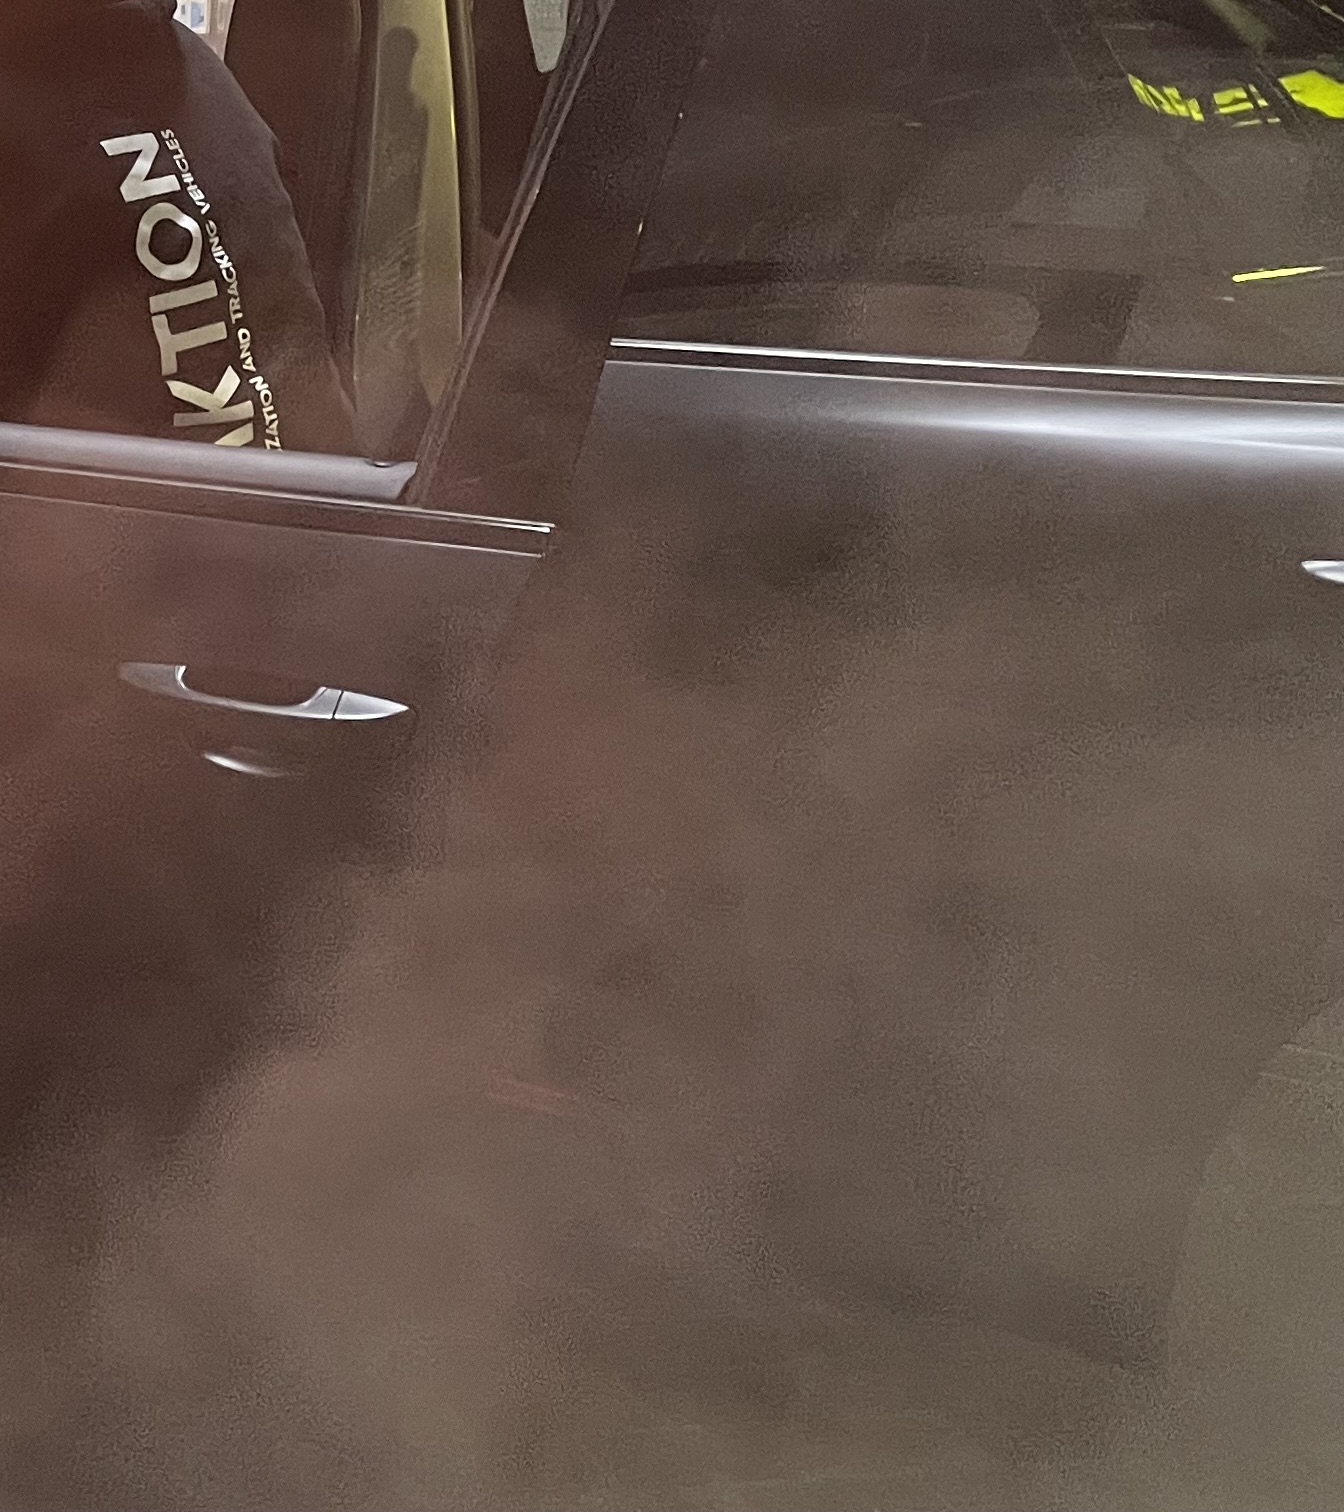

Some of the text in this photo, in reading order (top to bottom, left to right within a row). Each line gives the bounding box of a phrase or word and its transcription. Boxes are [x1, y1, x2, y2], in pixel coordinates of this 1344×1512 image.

[160, 128, 282, 452] ZATION AND TRACKING VEHICLES
